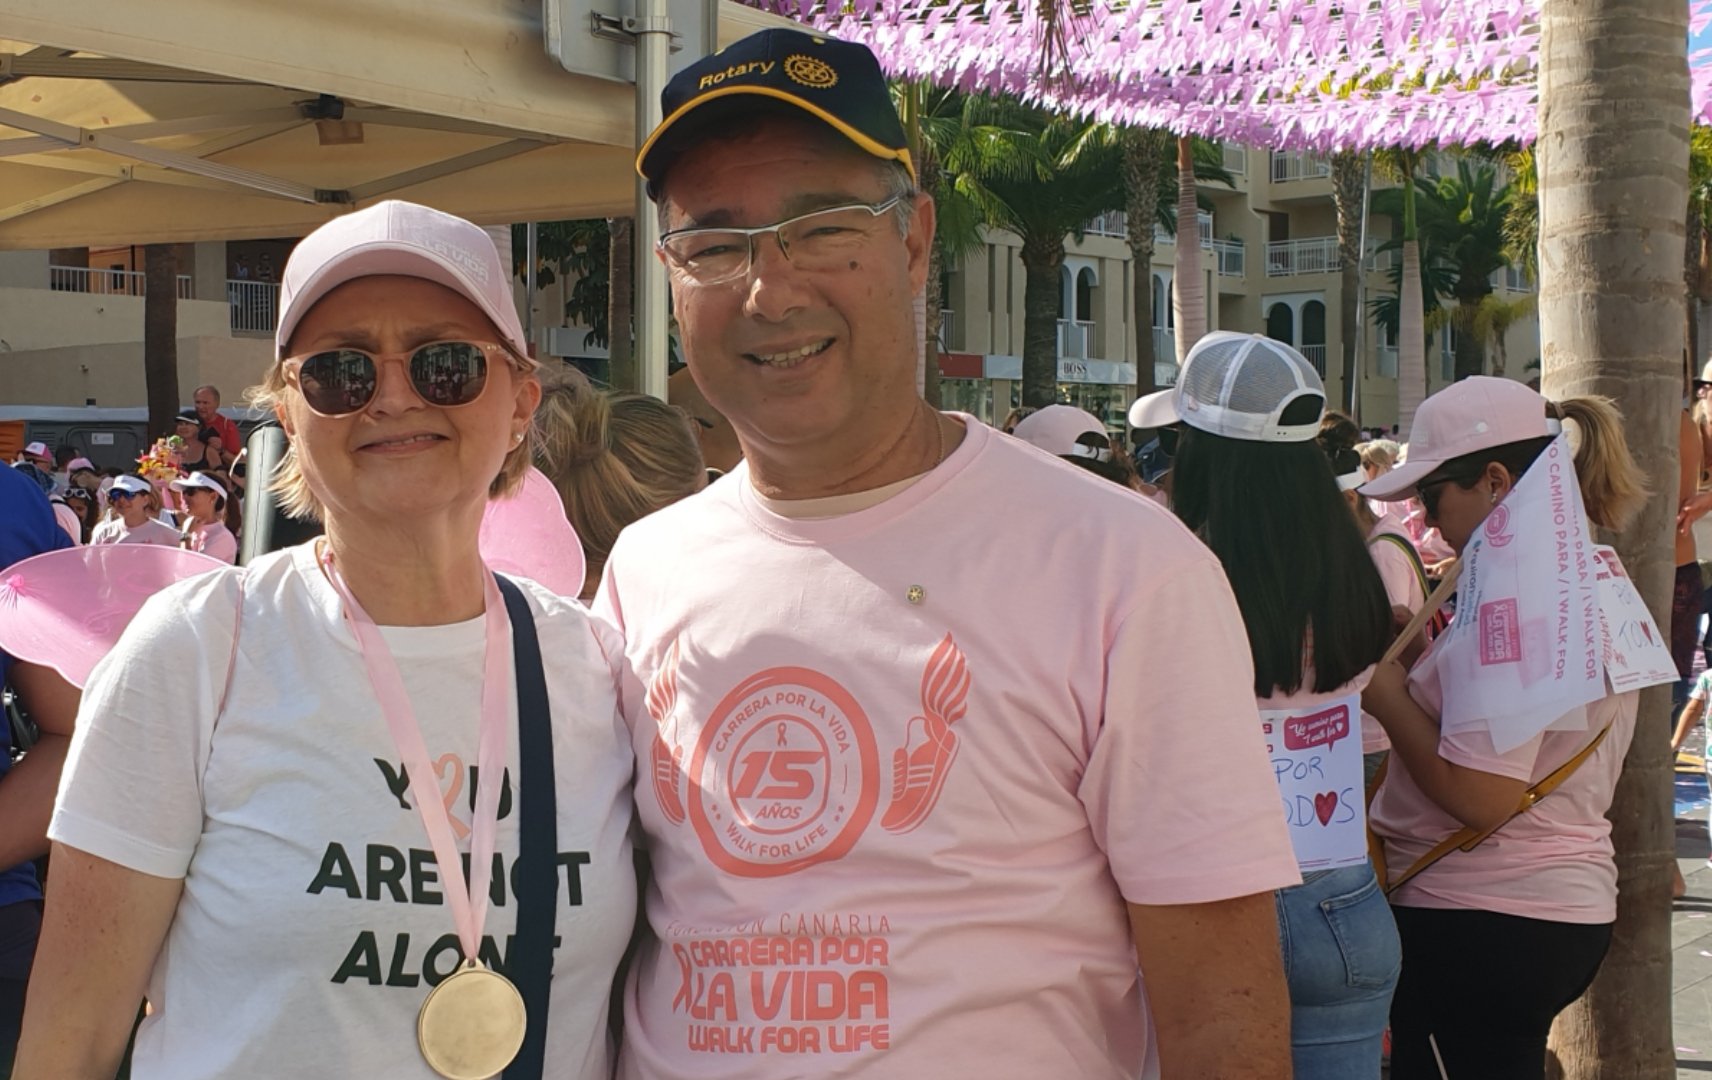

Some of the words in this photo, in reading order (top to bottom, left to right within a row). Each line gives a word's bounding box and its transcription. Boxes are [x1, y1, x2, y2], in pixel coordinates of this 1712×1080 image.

[699, 60, 775, 90] Rotary
[1063, 362, 1087, 374] BOSS
[1549, 463, 1564, 525] CAMINO
[1555, 531, 1569, 574] PARA
[1558, 598, 1569, 648] WALK
[1494, 629, 1506, 660] VIDA
[1554, 651, 1565, 682] FOR
[1585, 651, 1597, 682] FOR
[714, 695, 771, 753] CARRERA
[775, 691, 807, 706] POR
[809, 698, 827, 719] LA
[828, 715, 850, 754] VIDA
[1271, 756, 1324, 783] POR
[756, 802, 802, 820] AÑOS
[725, 821, 755, 853] WALK
[758, 843, 792, 858] FOR
[795, 823, 828, 852] LIFE
[306, 841, 443, 905] ARE
[462, 852, 591, 906] NT
[780, 912, 891, 936] CANARIA
[690, 936, 815, 967] CARRERA
[820, 936, 889, 966] POR
[690, 972, 738, 1021] LA
[751, 970, 889, 1021] VIDA
[688, 1024, 754, 1053] WALK
[760, 1025, 820, 1053] FOR
[828, 1024, 890, 1053] LIFE
